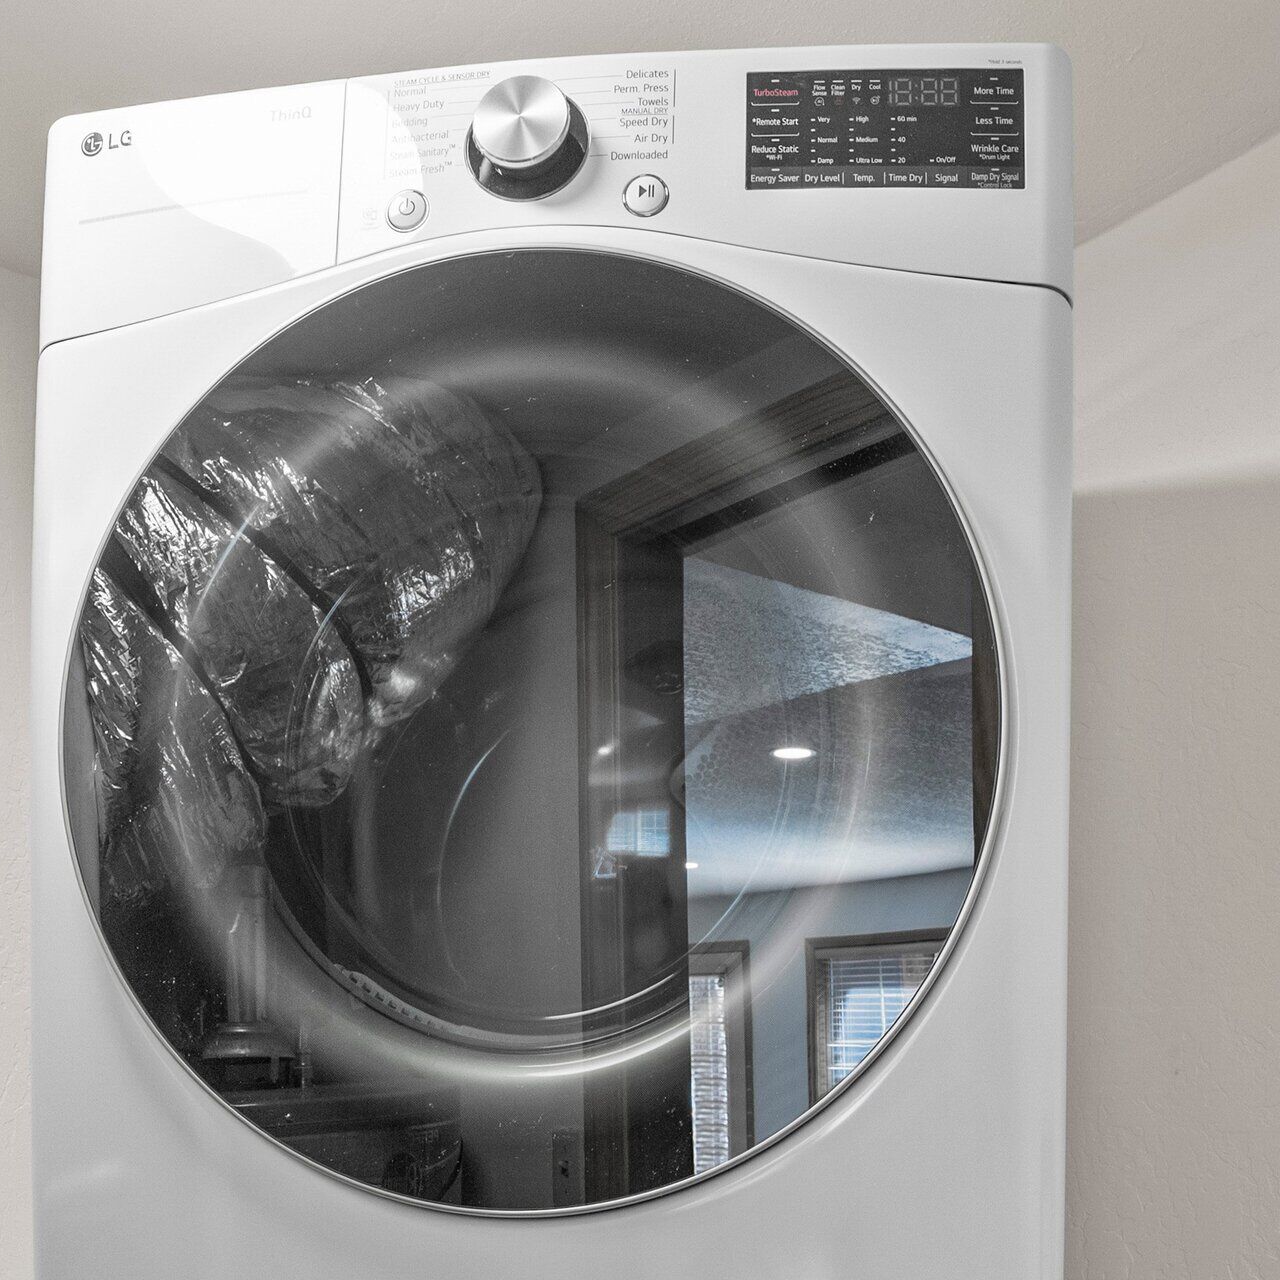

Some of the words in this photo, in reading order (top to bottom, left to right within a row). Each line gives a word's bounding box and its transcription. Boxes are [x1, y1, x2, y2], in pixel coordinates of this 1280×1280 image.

[625, 68, 669, 79] Delicates
[393, 86, 426, 98] Normal
[613, 84, 640, 95] Perm.
[643, 83, 669, 93] Press
[753, 88, 799, 97] TurboSteam
[973, 87, 994, 95] More
[995, 87, 1015, 95] Time
[393, 102, 421, 113] Heavy
[423, 100, 445, 110] Duty
[637, 96, 669, 107] Towels
[269, 105, 313, 122] ThinQ
[620, 108, 650, 116] MANUAL
[652, 107, 669, 115] DRY
[619, 117, 648, 129] Speed
[651, 116, 669, 129] Dry
[781, 117, 799, 126] Start
[817, 116, 830, 124] Very
[975, 117, 993, 125] Less
[995, 116, 1014, 125] Time
[108, 130, 132, 150] LG
[634, 133, 648, 143] Air
[650, 133, 669, 145] Dry
[751, 145, 777, 153] Reduce
[778, 145, 799, 153] Static
[971, 144, 999, 153] Wrinkle
[1001, 145, 1019, 153] Care
[610, 149, 669, 161] Downloaded
[936, 156, 956, 164] On/Off
[817, 157, 833, 165] Damp
[750, 174, 776, 184] Energy
[778, 174, 799, 183] Saver
[805, 174, 819, 184] Dry
[820, 174, 840, 183] Level
[853, 174, 875, 184] Temp.
[889, 174, 907, 183] Time
[909, 174, 923, 184] Dry
[935, 174, 958, 184] Signal
[971, 172, 988, 182] Damp
[989, 172, 1000, 182] Dry
[1001, 172, 1019, 182] Signal
